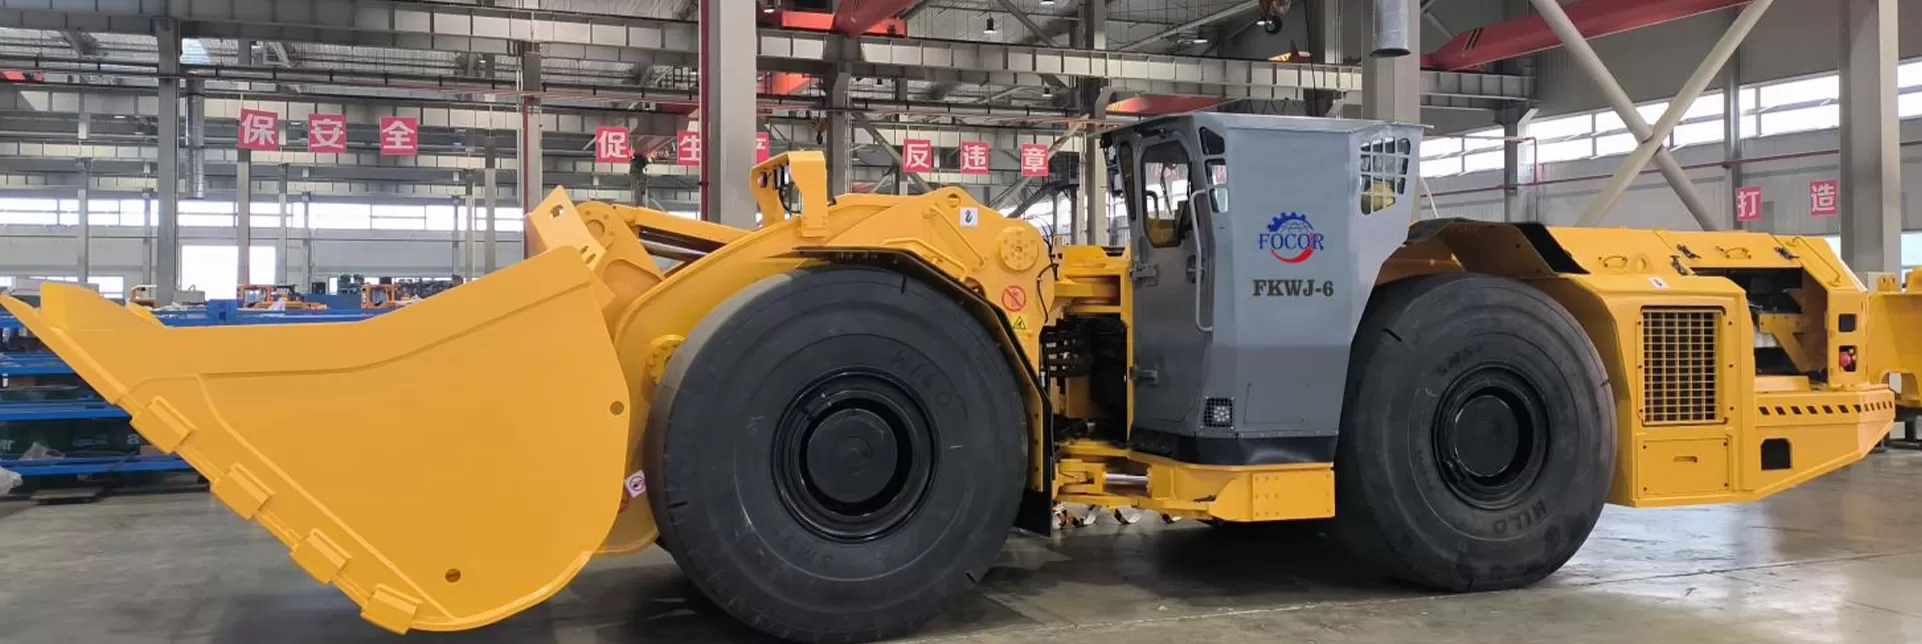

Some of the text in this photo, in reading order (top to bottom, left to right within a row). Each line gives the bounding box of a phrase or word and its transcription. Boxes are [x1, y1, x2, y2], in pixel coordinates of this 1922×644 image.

[241, 113, 415, 149] 保安全
[905, 143, 1047, 172] 反违章
[1737, 183, 1835, 217] 打造
[1258, 233, 1324, 251] FOCOR
[1252, 279, 1334, 297] FKWJ-6
